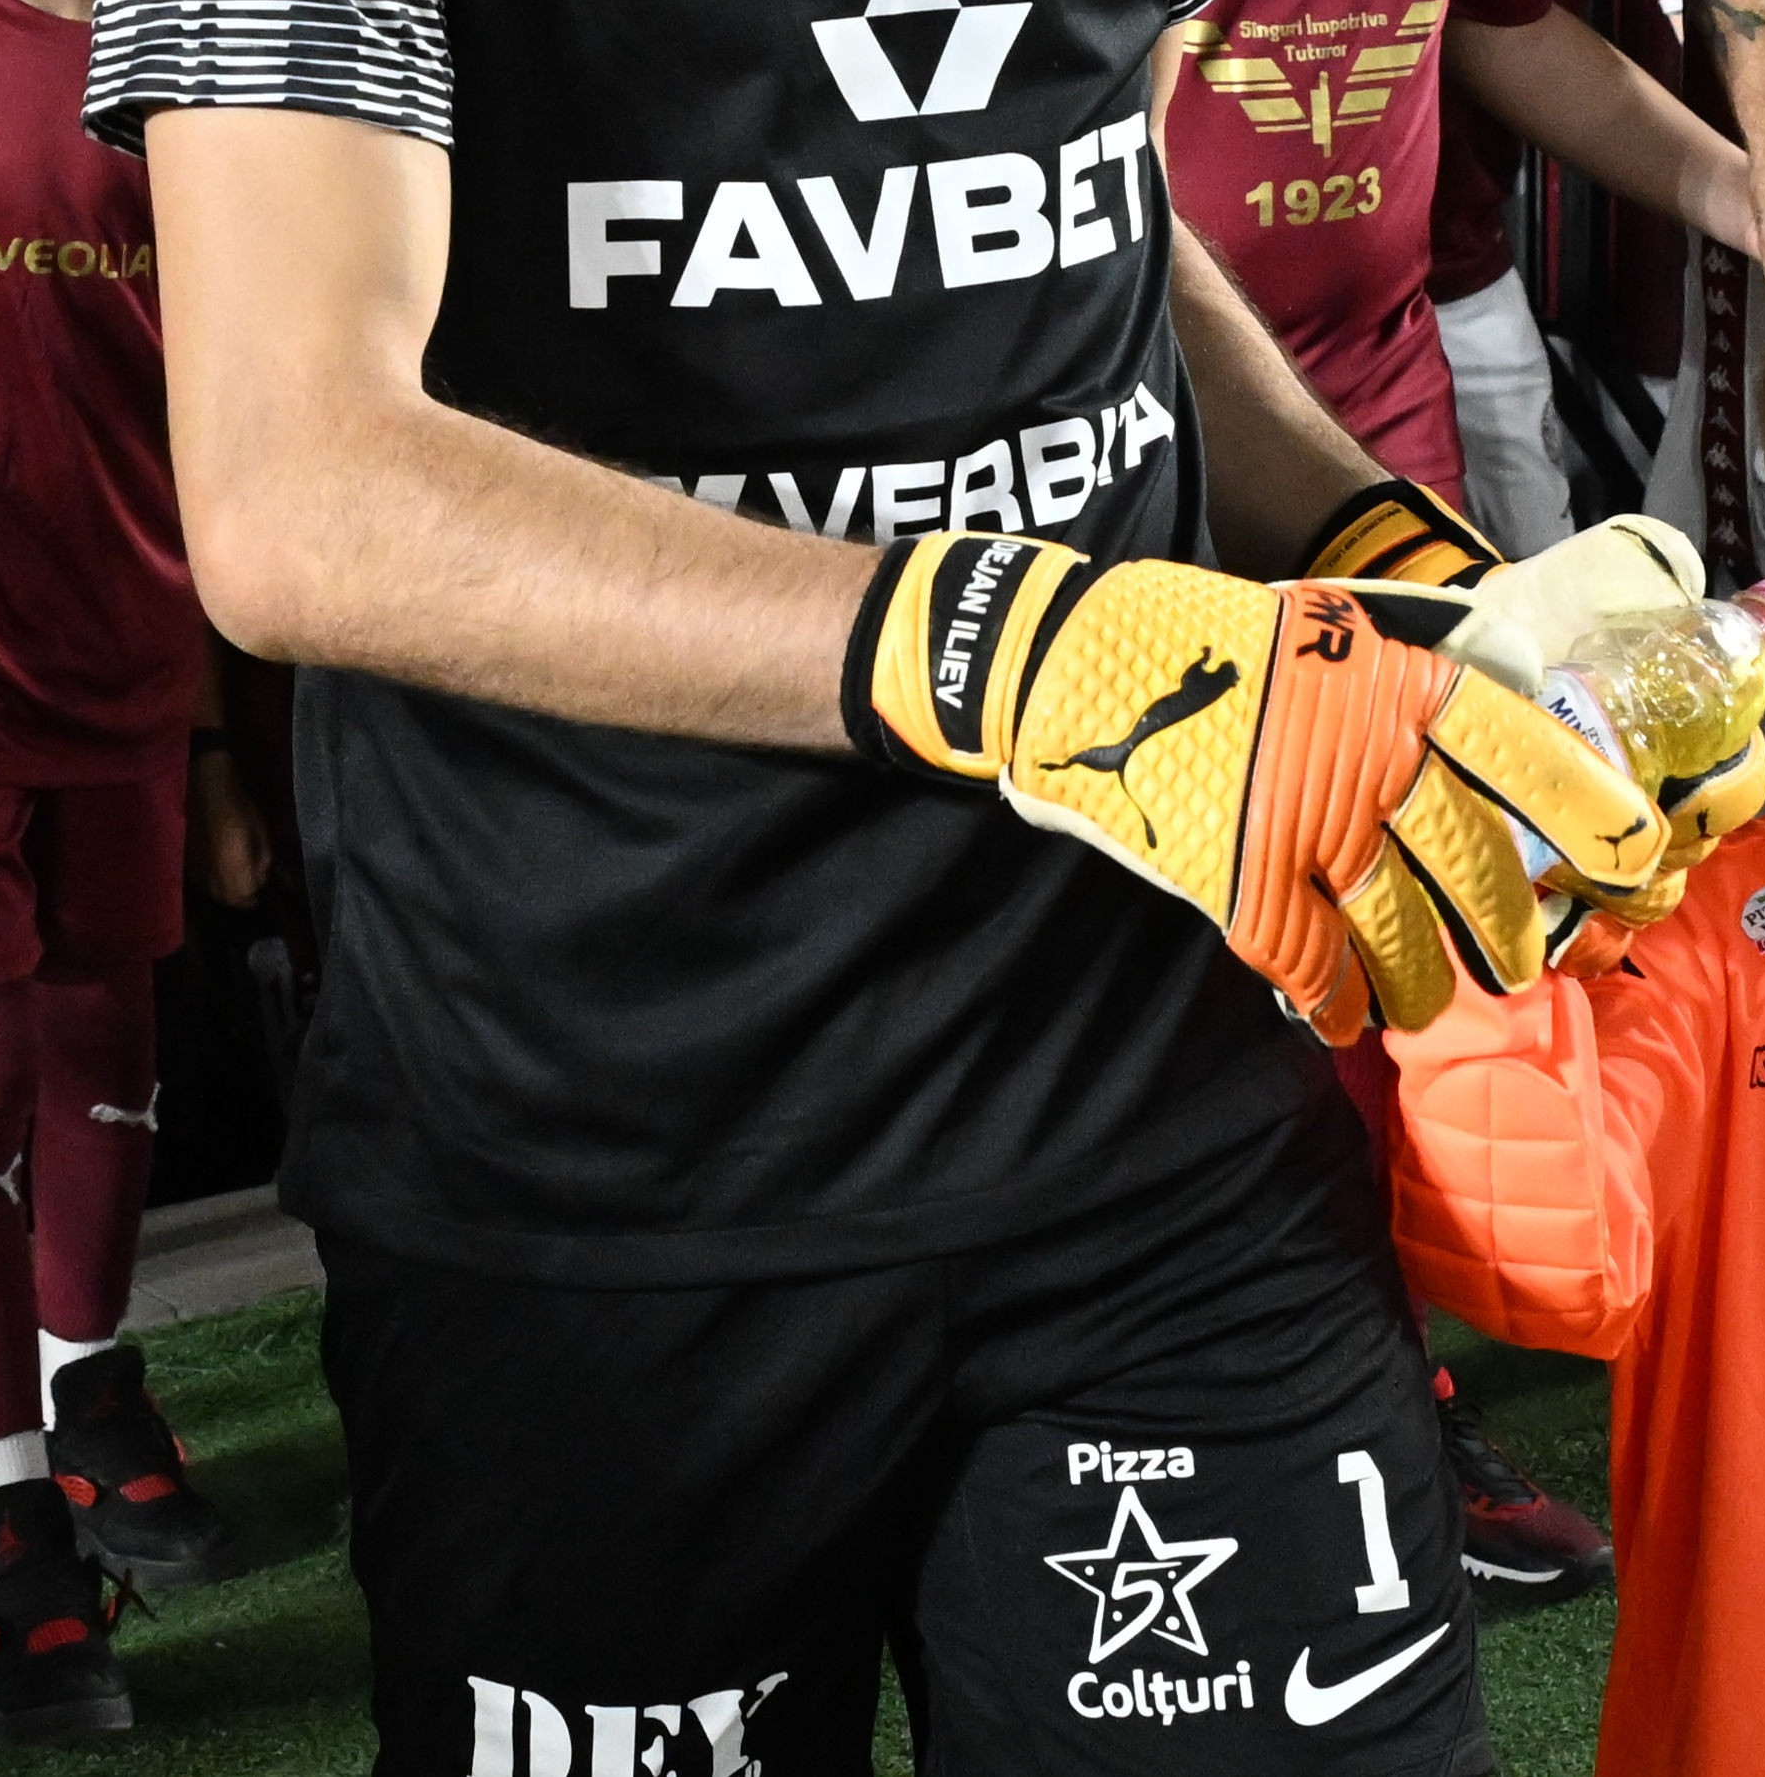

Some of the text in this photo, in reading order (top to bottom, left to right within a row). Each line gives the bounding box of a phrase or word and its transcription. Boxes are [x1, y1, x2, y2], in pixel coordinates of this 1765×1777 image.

[568, 111, 1151, 309] FAVBET
[1245, 166, 1382, 227] 1923
[935, 540, 1025, 710] DEJAN ILIEV
[1587, 726, 1611, 760] IZVO
[1068, 1442, 1196, 1487] Pizza
[1338, 1451, 1410, 1614] 1
[1068, 1661, 1254, 1727] Colțuri
